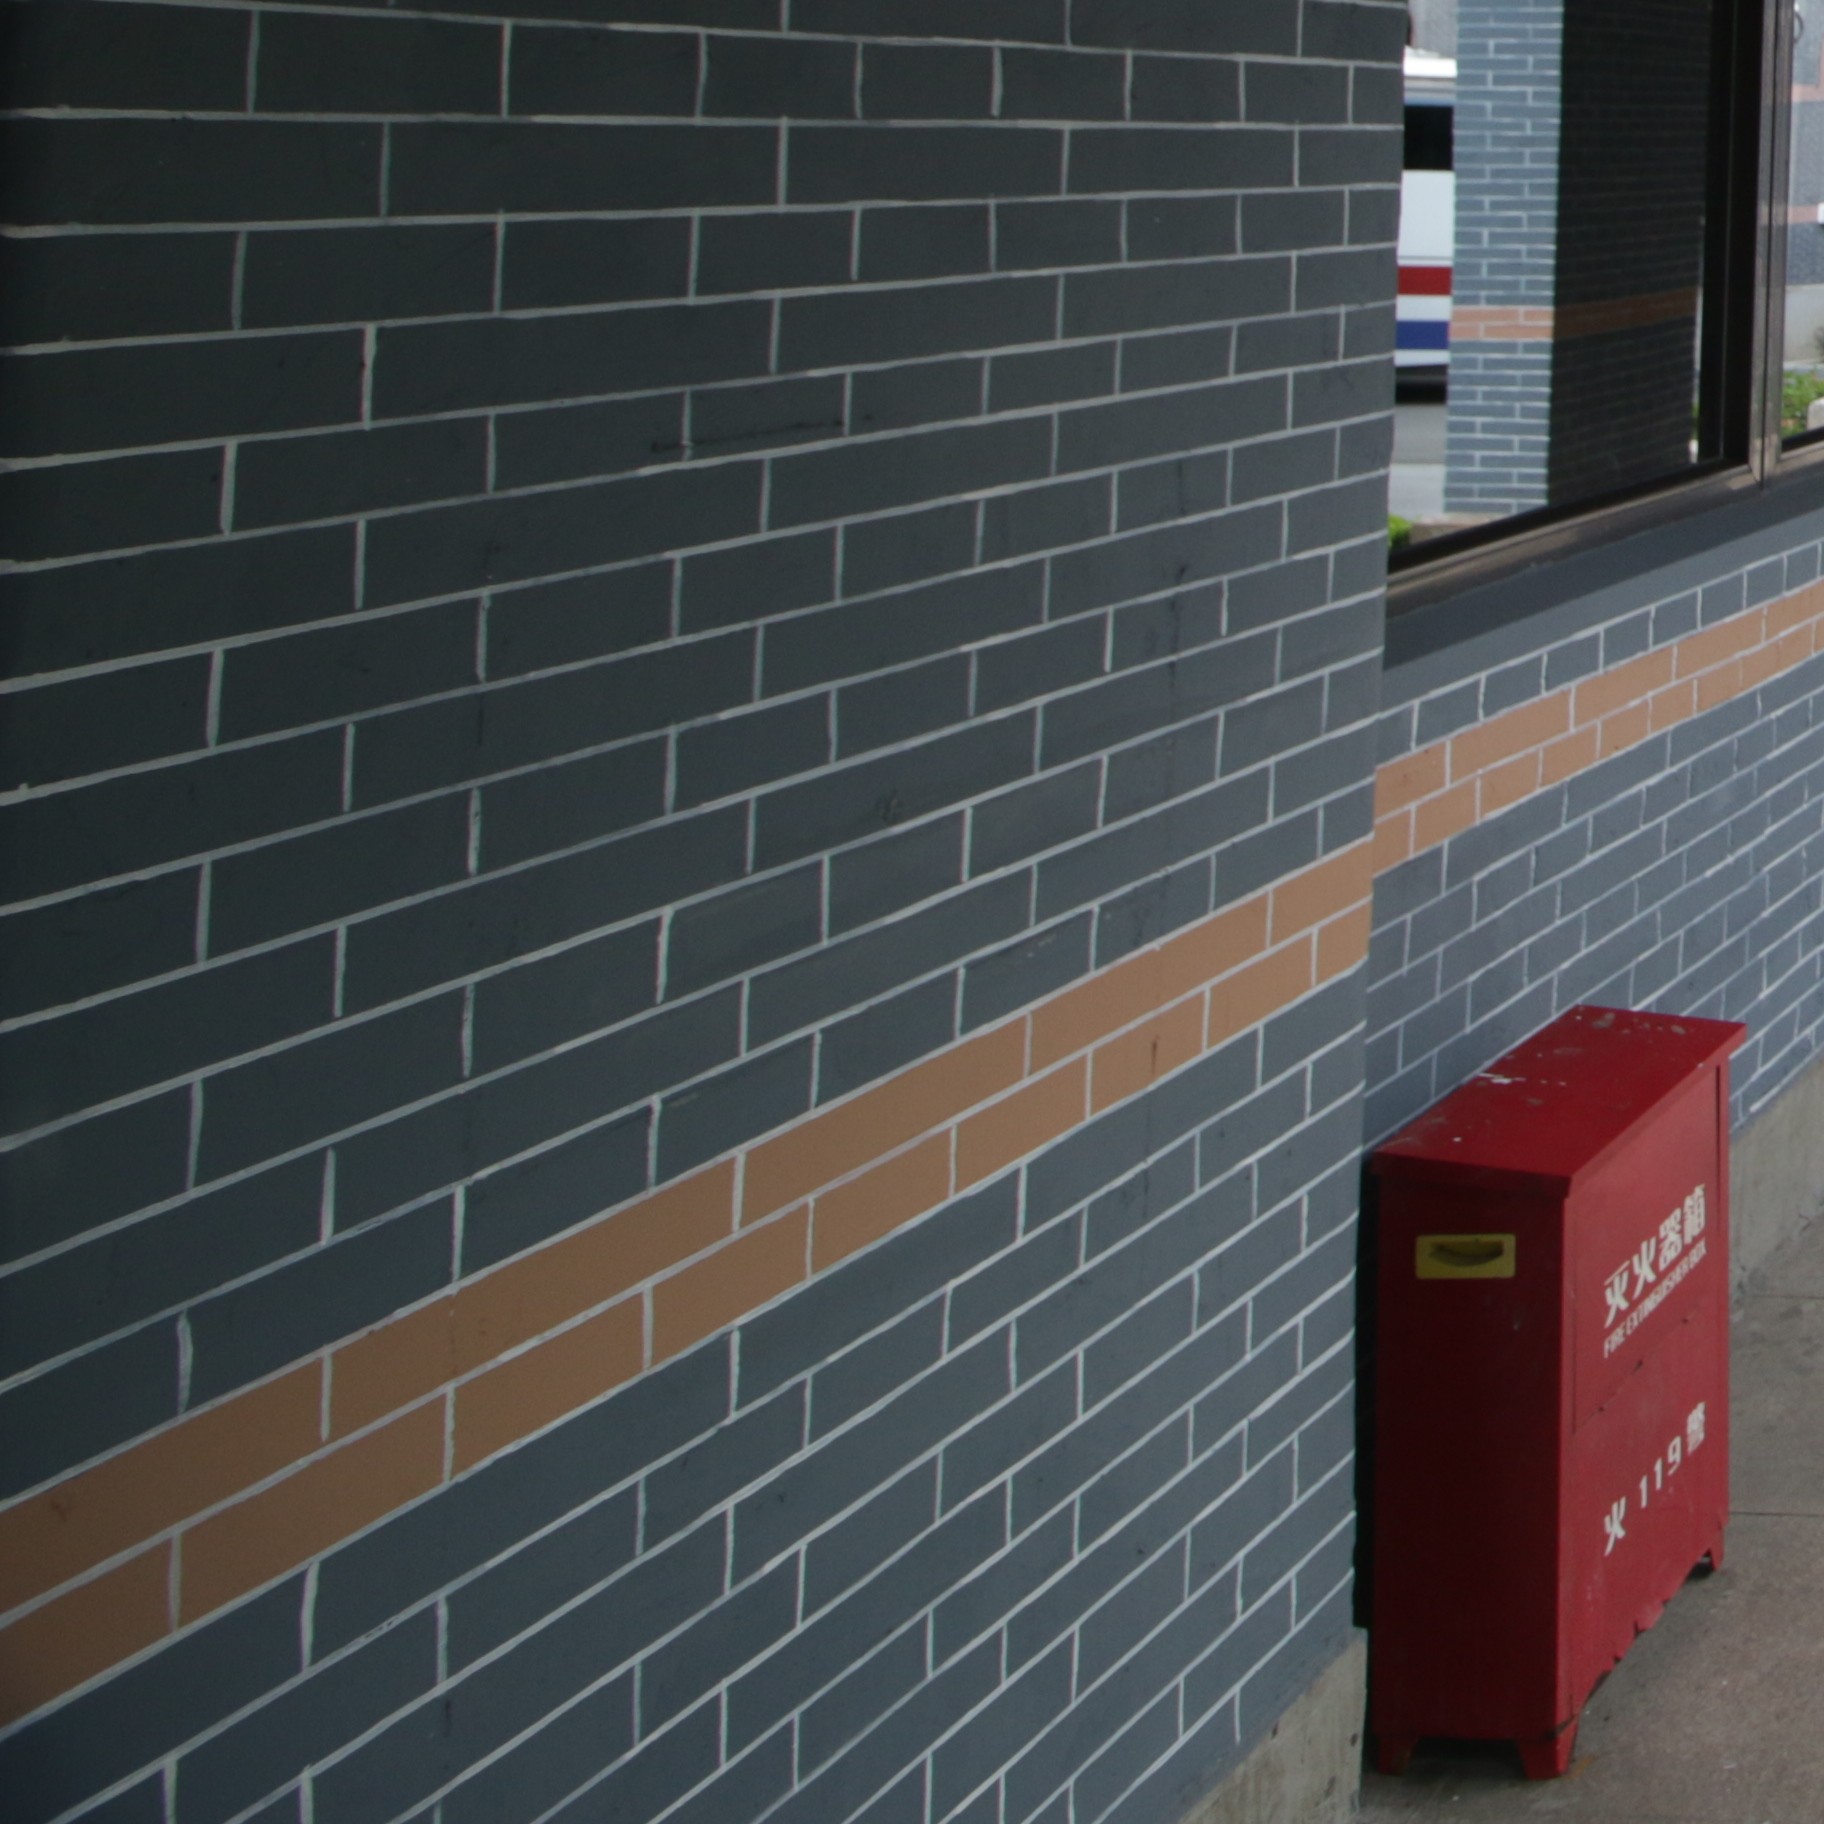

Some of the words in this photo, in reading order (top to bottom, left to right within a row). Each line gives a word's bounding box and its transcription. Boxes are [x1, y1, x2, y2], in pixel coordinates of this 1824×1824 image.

[1603, 1183, 1706, 1329] 灭火器箱
[1603, 1326, 1627, 1360] FIRE
[1625, 1260, 1687, 1337] EXTINGUISHER
[1687, 1237, 1706, 1274] BOX
